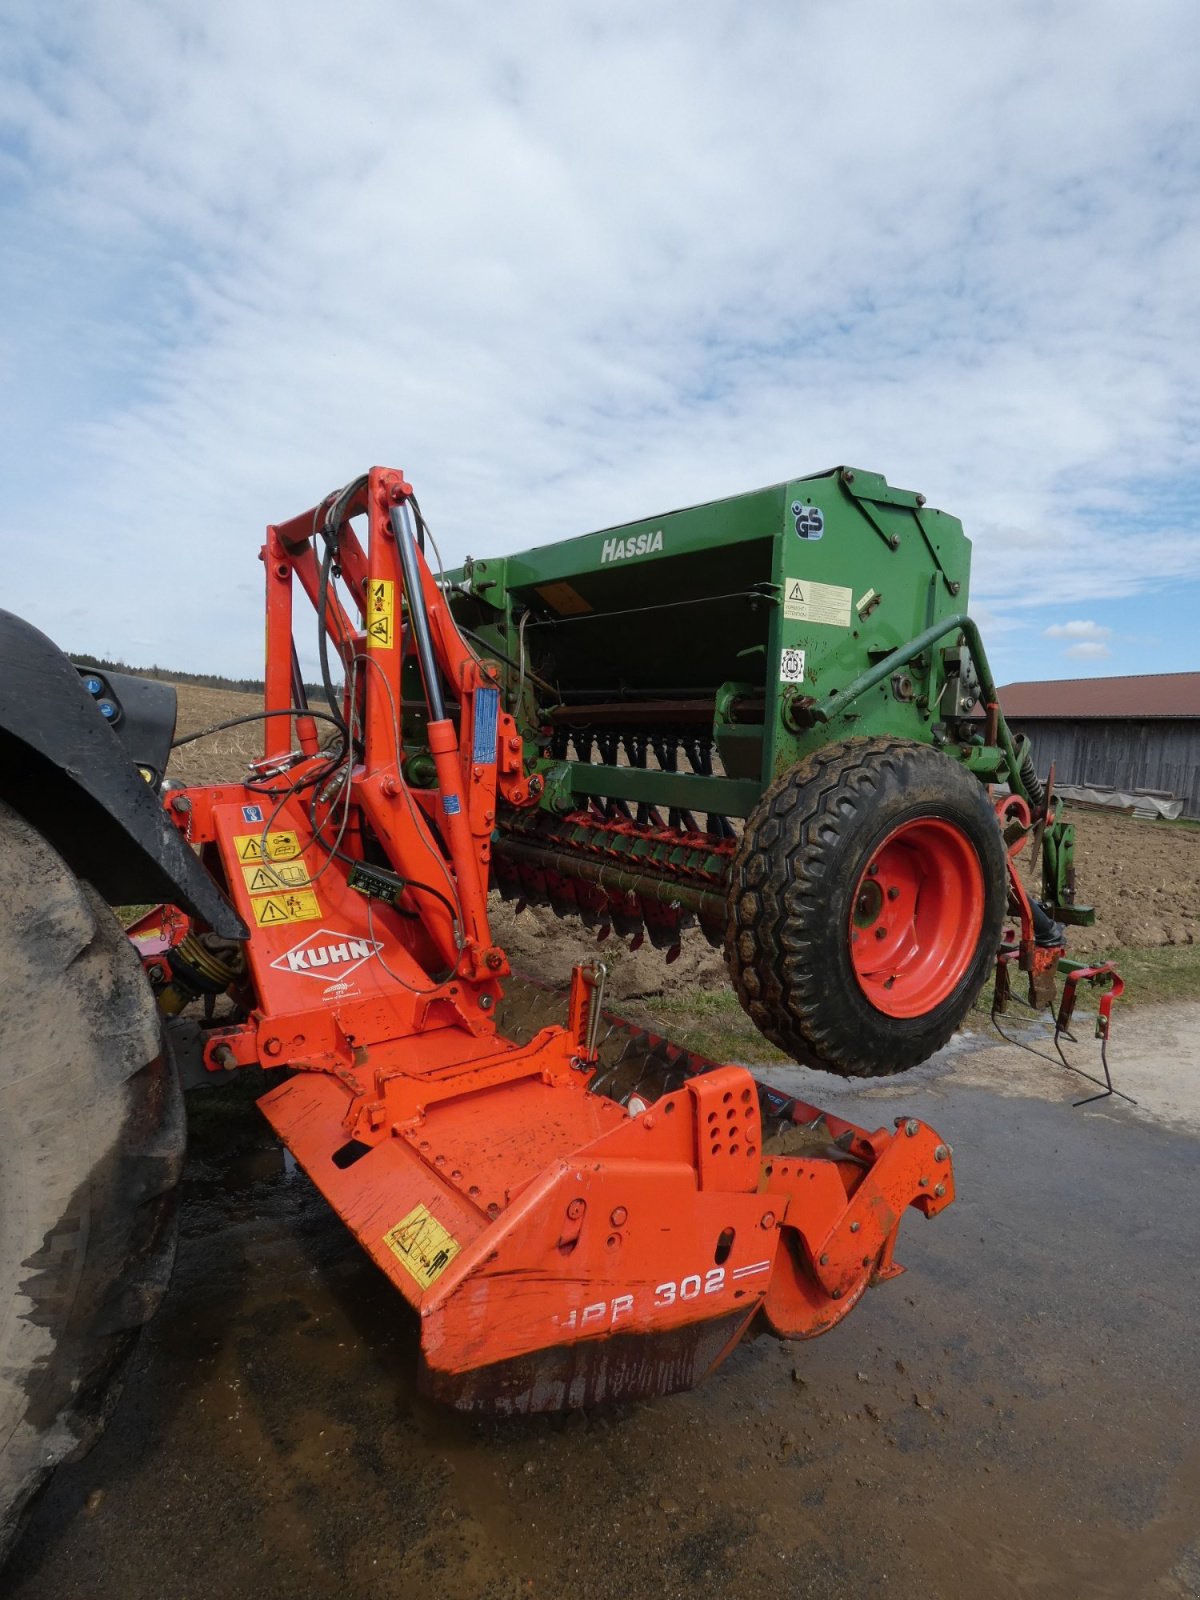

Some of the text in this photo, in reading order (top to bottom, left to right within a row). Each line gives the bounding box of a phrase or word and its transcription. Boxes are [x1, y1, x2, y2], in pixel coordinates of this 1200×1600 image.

[796, 508, 823, 539] GS
[601, 530, 663, 563] HASSIA
[286, 940, 370, 971] KUHN
[654, 1267, 725, 1307] 302
